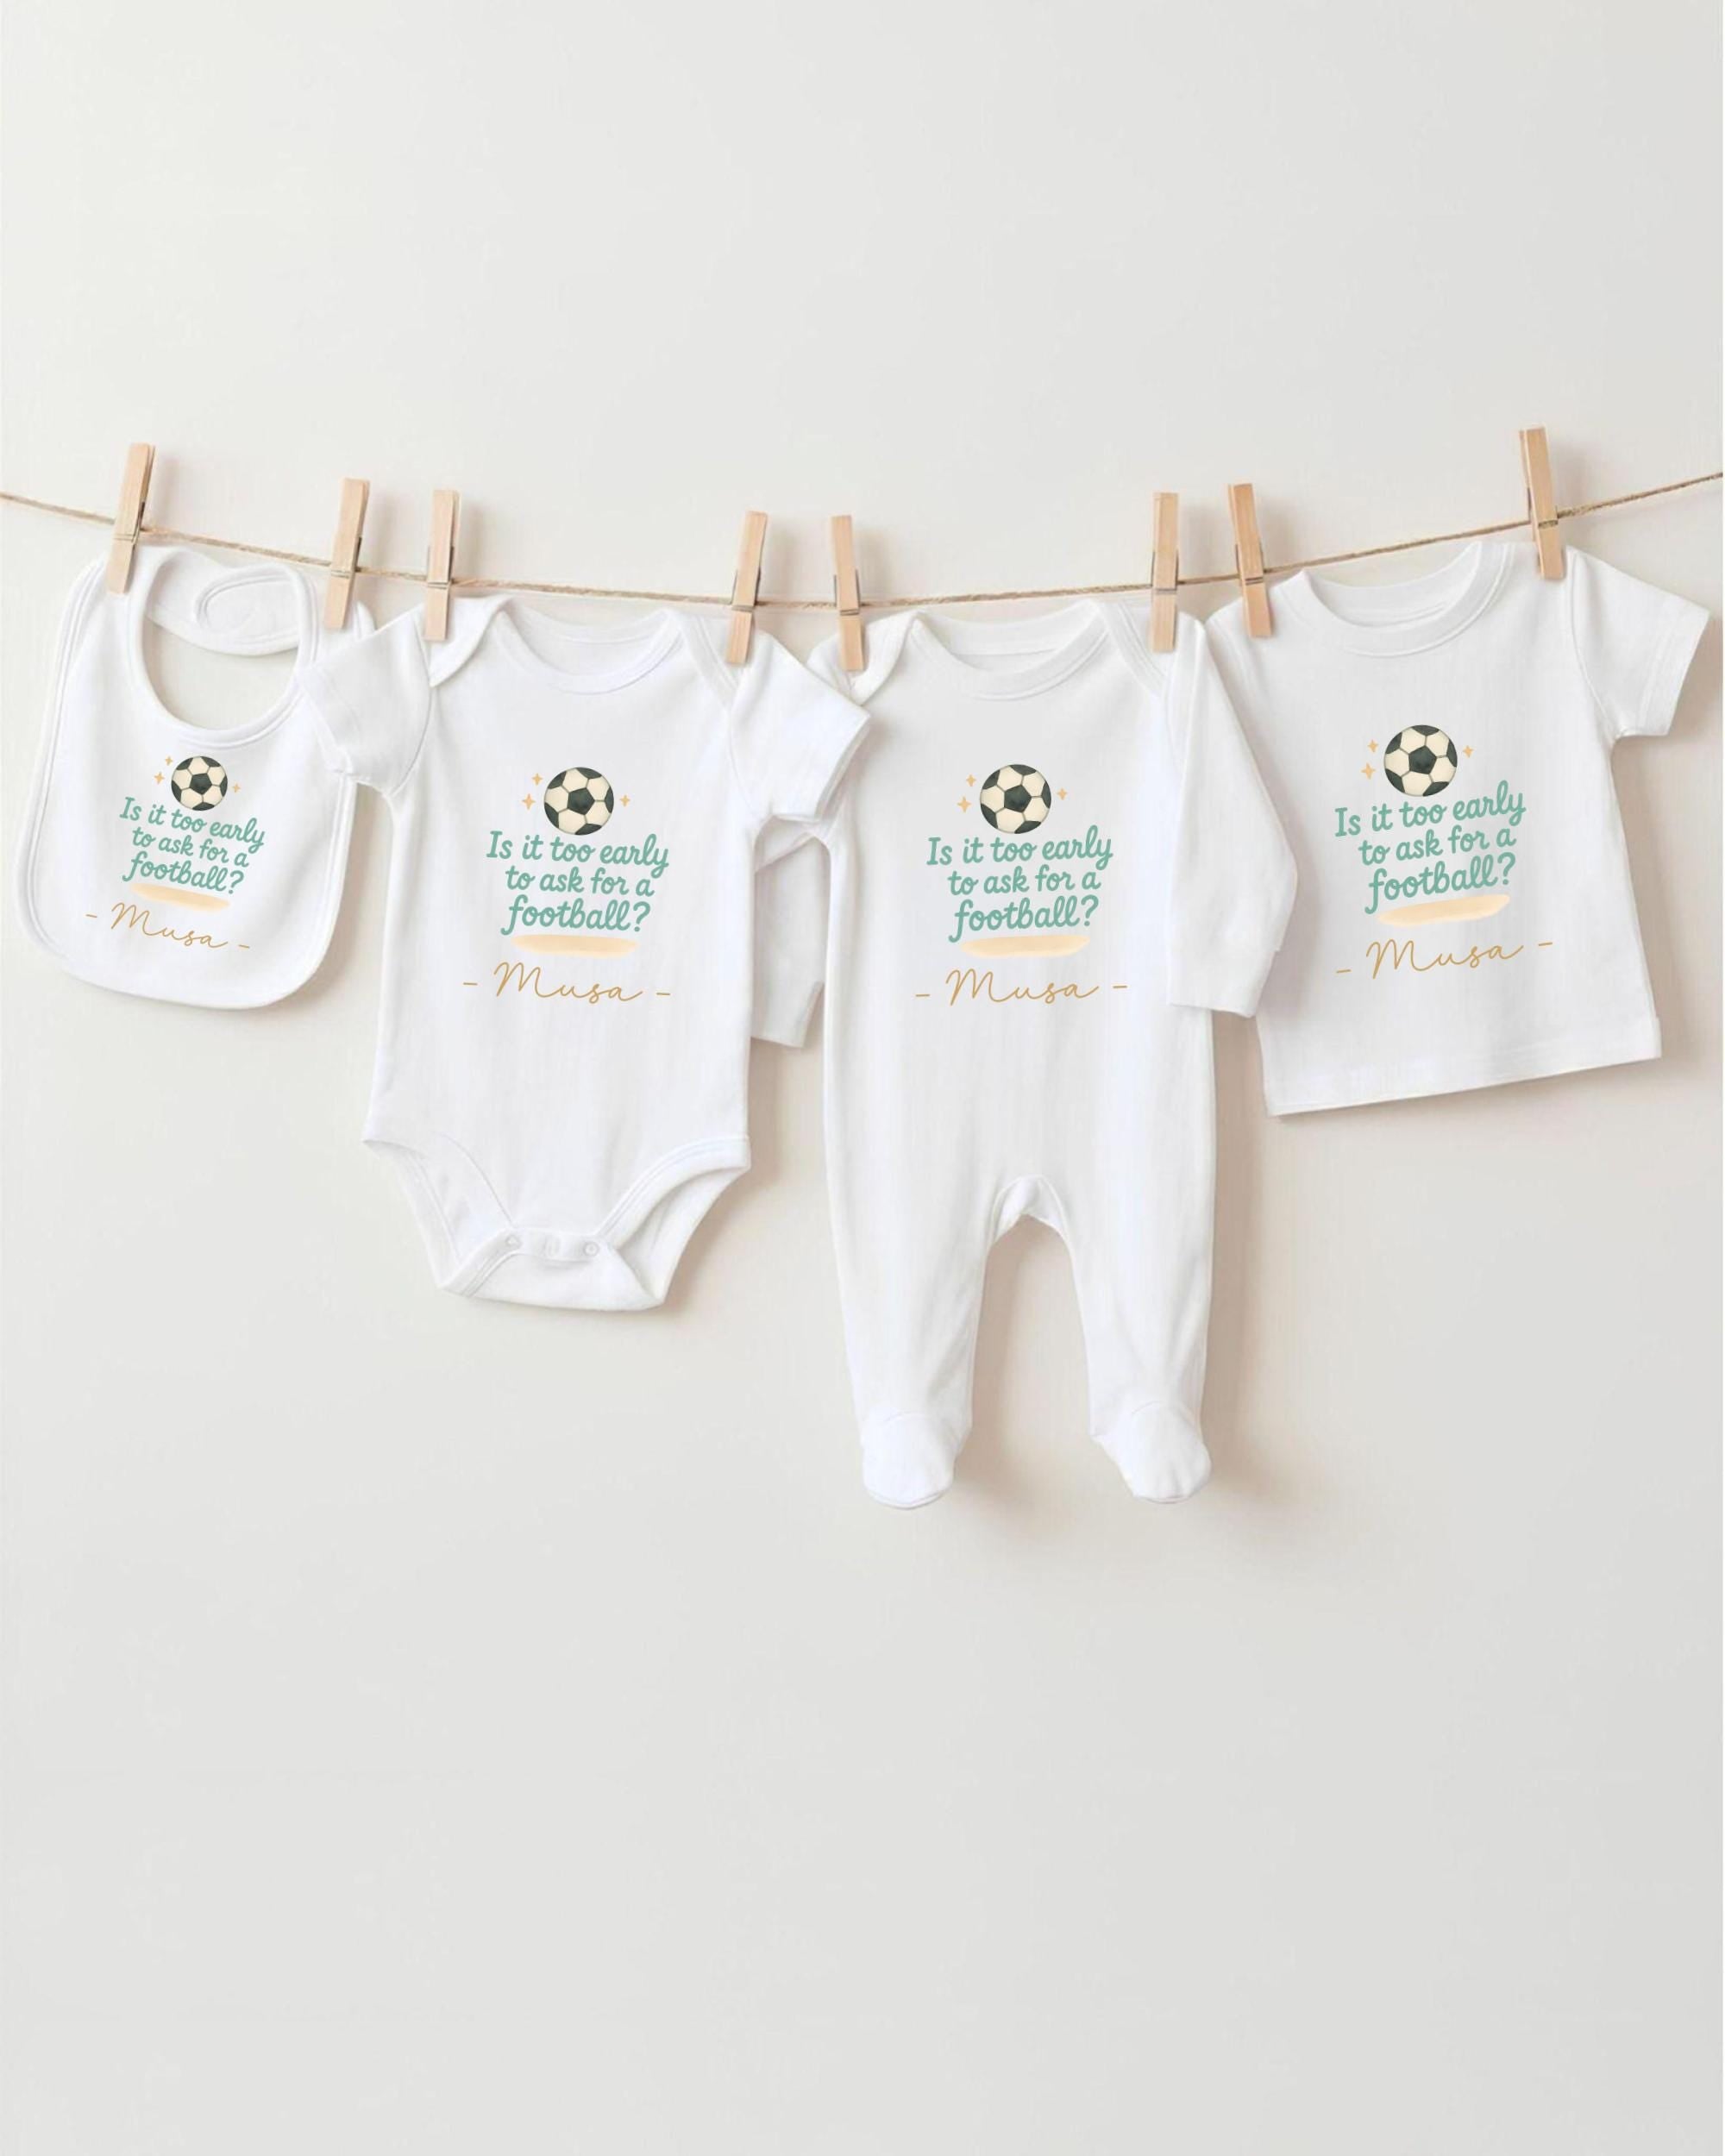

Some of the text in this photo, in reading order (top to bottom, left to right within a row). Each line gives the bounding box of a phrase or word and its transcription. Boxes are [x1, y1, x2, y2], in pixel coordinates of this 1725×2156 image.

[119, 796, 266, 855] Is it too early
[1334, 779, 1527, 838] Is it too early
[132, 826, 249, 868] to ask for a
[485, 830, 670, 880] Is it too early
[925, 824, 1114, 871] Is it too early
[1358, 824, 1518, 867] to ask for a
[122, 850, 245, 894] football?
[505, 865, 656, 898] to ask for a
[946, 864, 1102, 897] to ask for a
[1364, 851, 1517, 916] football?
[110, 902, 229, 949] Musa
[499, 894, 652, 937] football?
[947, 894, 1101, 944] football?
[1365, 938, 1525, 981] Musa
[492, 962, 644, 1005] Musa
[945, 968, 1100, 1006] Musa
